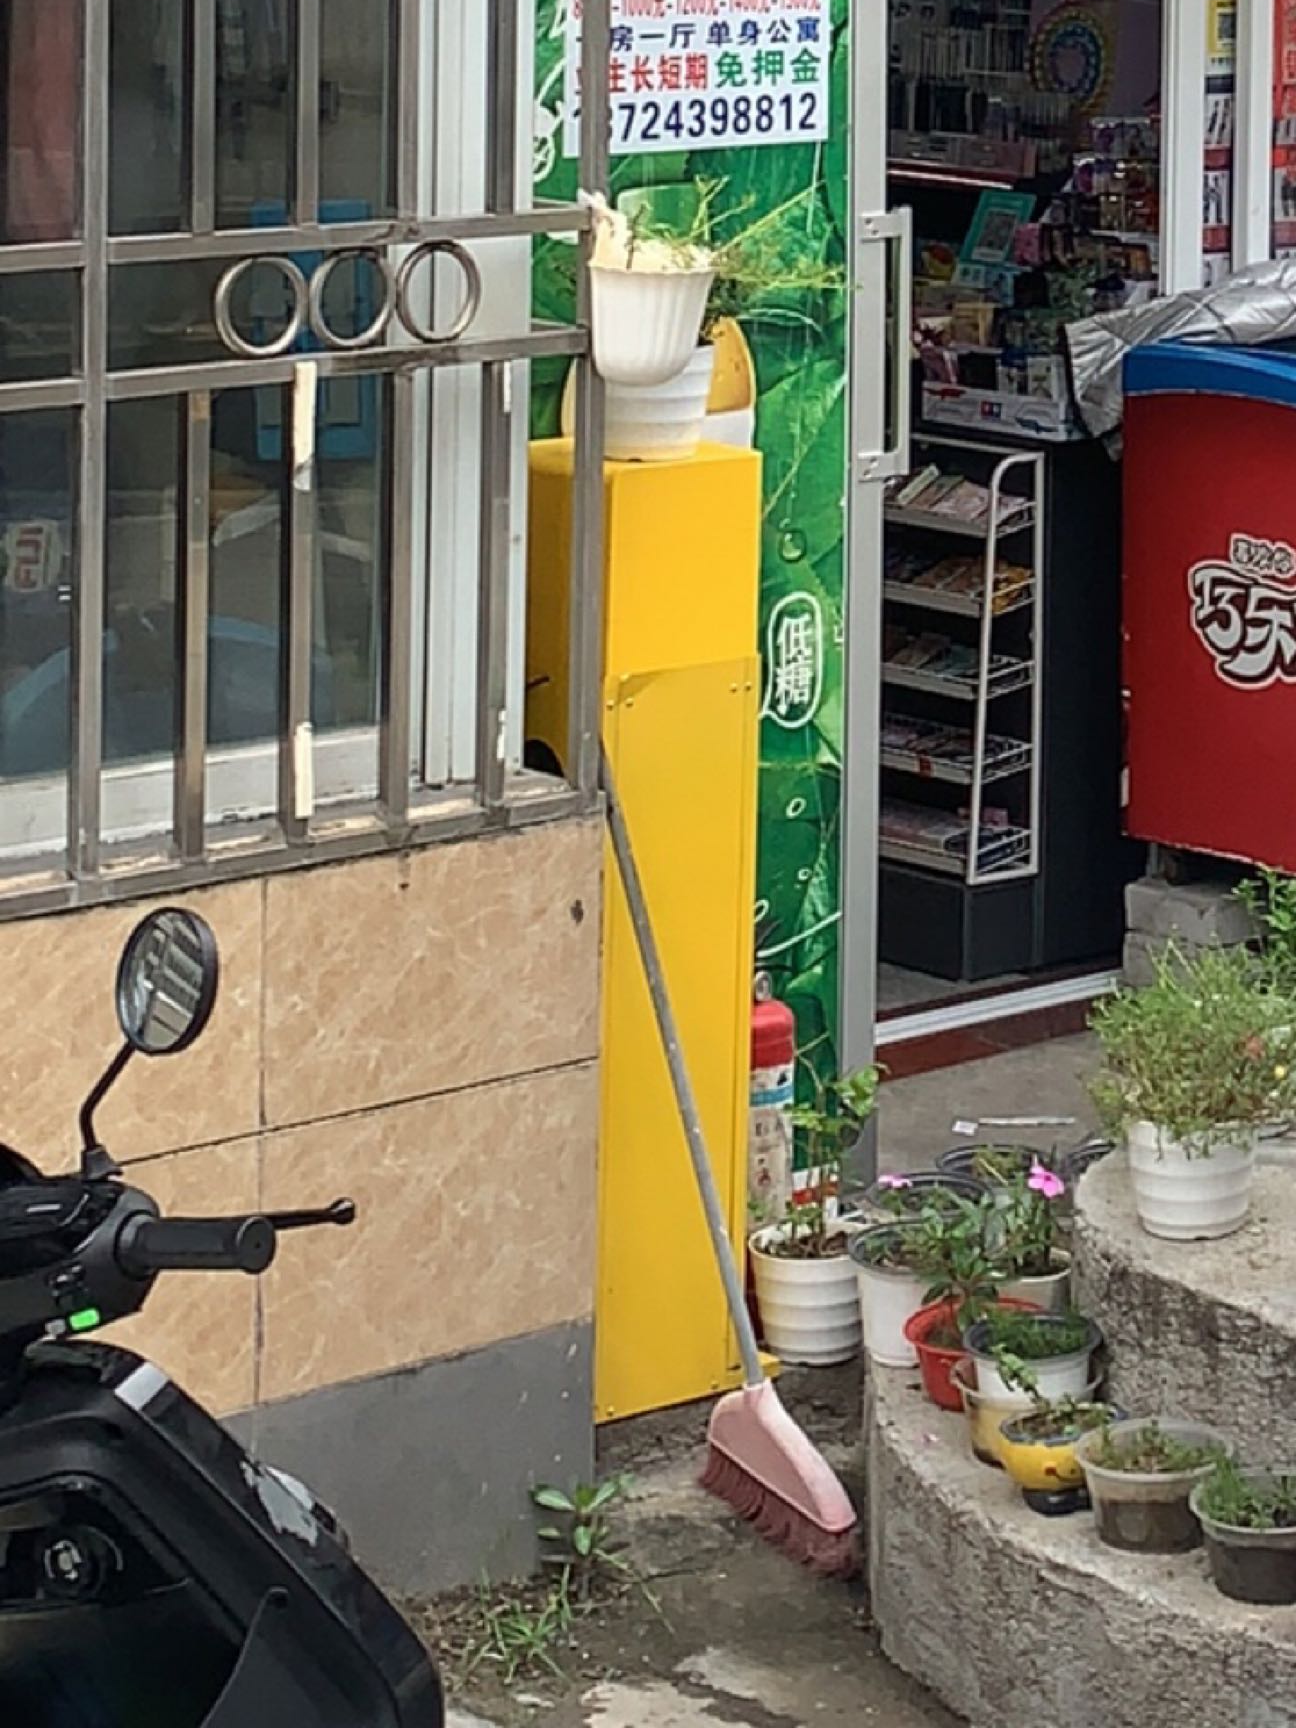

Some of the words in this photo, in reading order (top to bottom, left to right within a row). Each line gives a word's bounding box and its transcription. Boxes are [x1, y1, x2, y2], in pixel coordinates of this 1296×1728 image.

[576, 23, 697, 53] 房一厅
[705, 17, 820, 47] 单身公寓
[715, 47, 822, 89] 免押金
